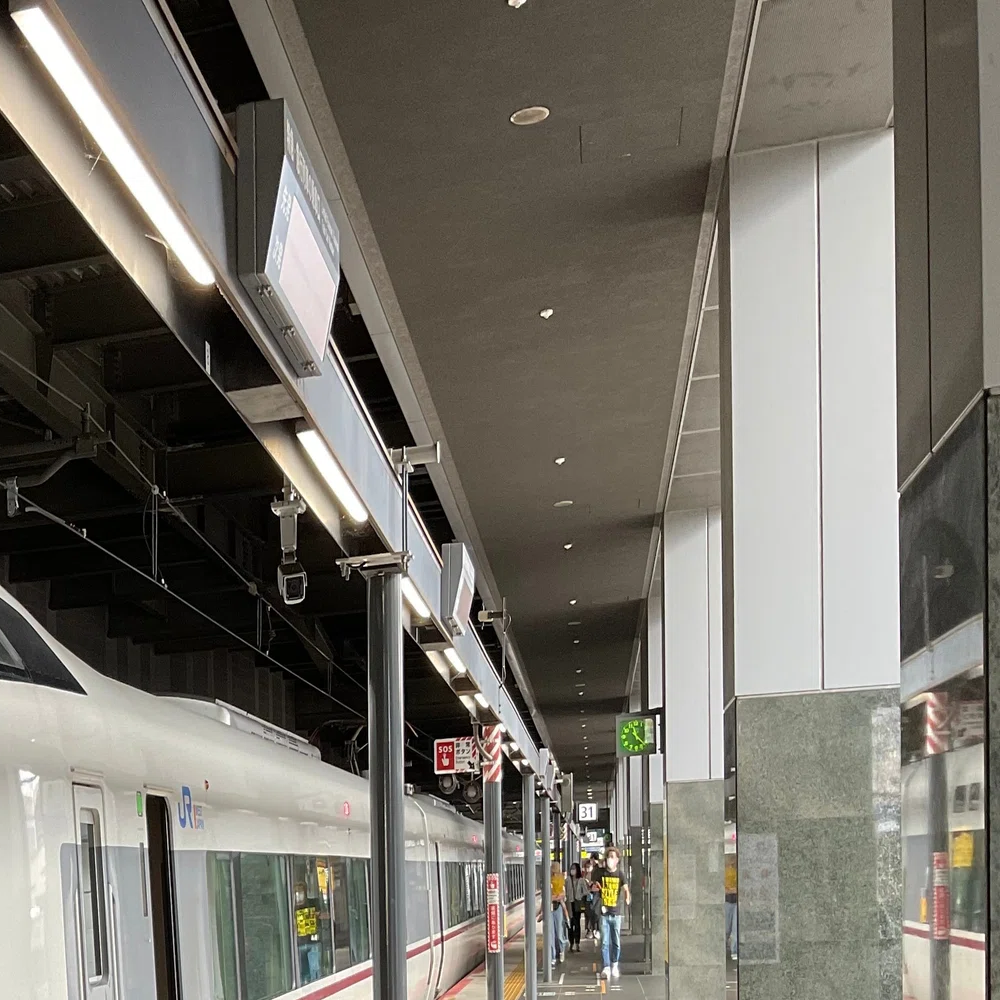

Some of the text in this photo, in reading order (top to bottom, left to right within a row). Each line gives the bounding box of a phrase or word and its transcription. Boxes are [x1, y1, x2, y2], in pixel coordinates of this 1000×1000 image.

[438, 745, 453, 753] SOS
[177, 785, 194, 829] JR
[581, 806, 593, 819] 31
